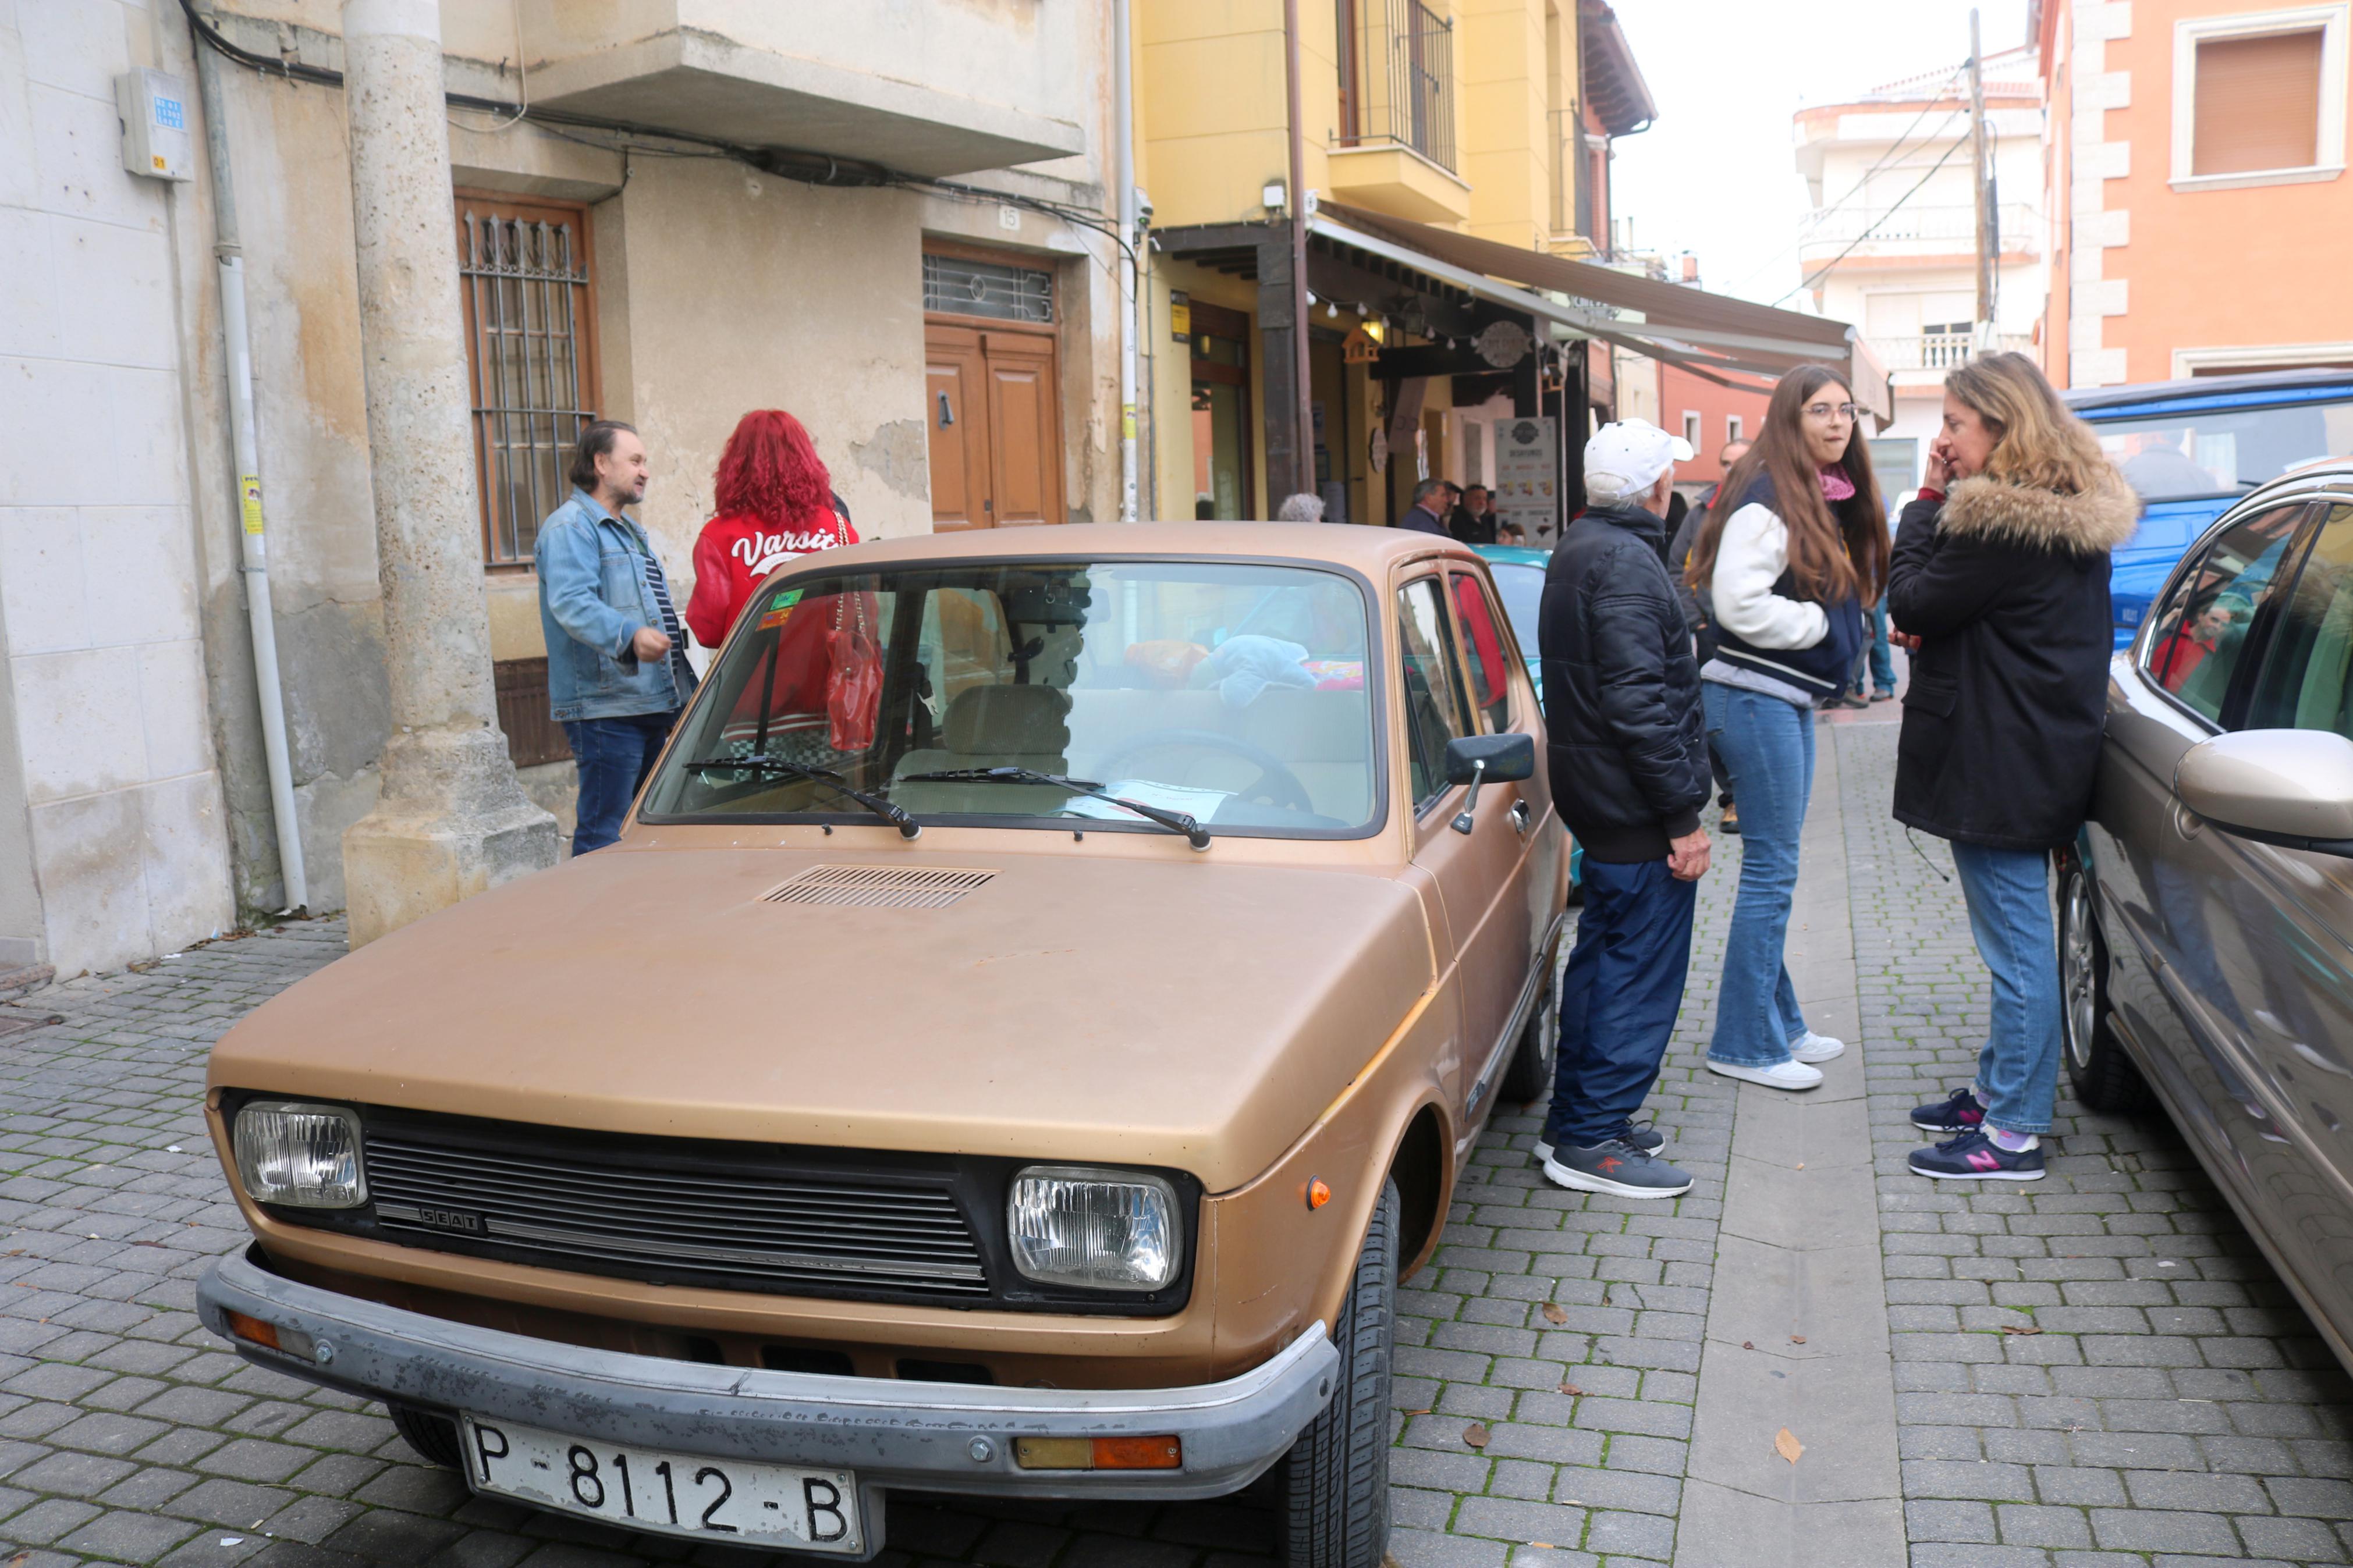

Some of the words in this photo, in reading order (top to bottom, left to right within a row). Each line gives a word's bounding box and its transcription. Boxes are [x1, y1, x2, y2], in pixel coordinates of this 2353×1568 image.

[154, 157, 164, 168] 01
[1004, 209, 1016, 226] 15
[731, 528, 839, 567] Varsit
[423, 1211, 475, 1229] SEAT
